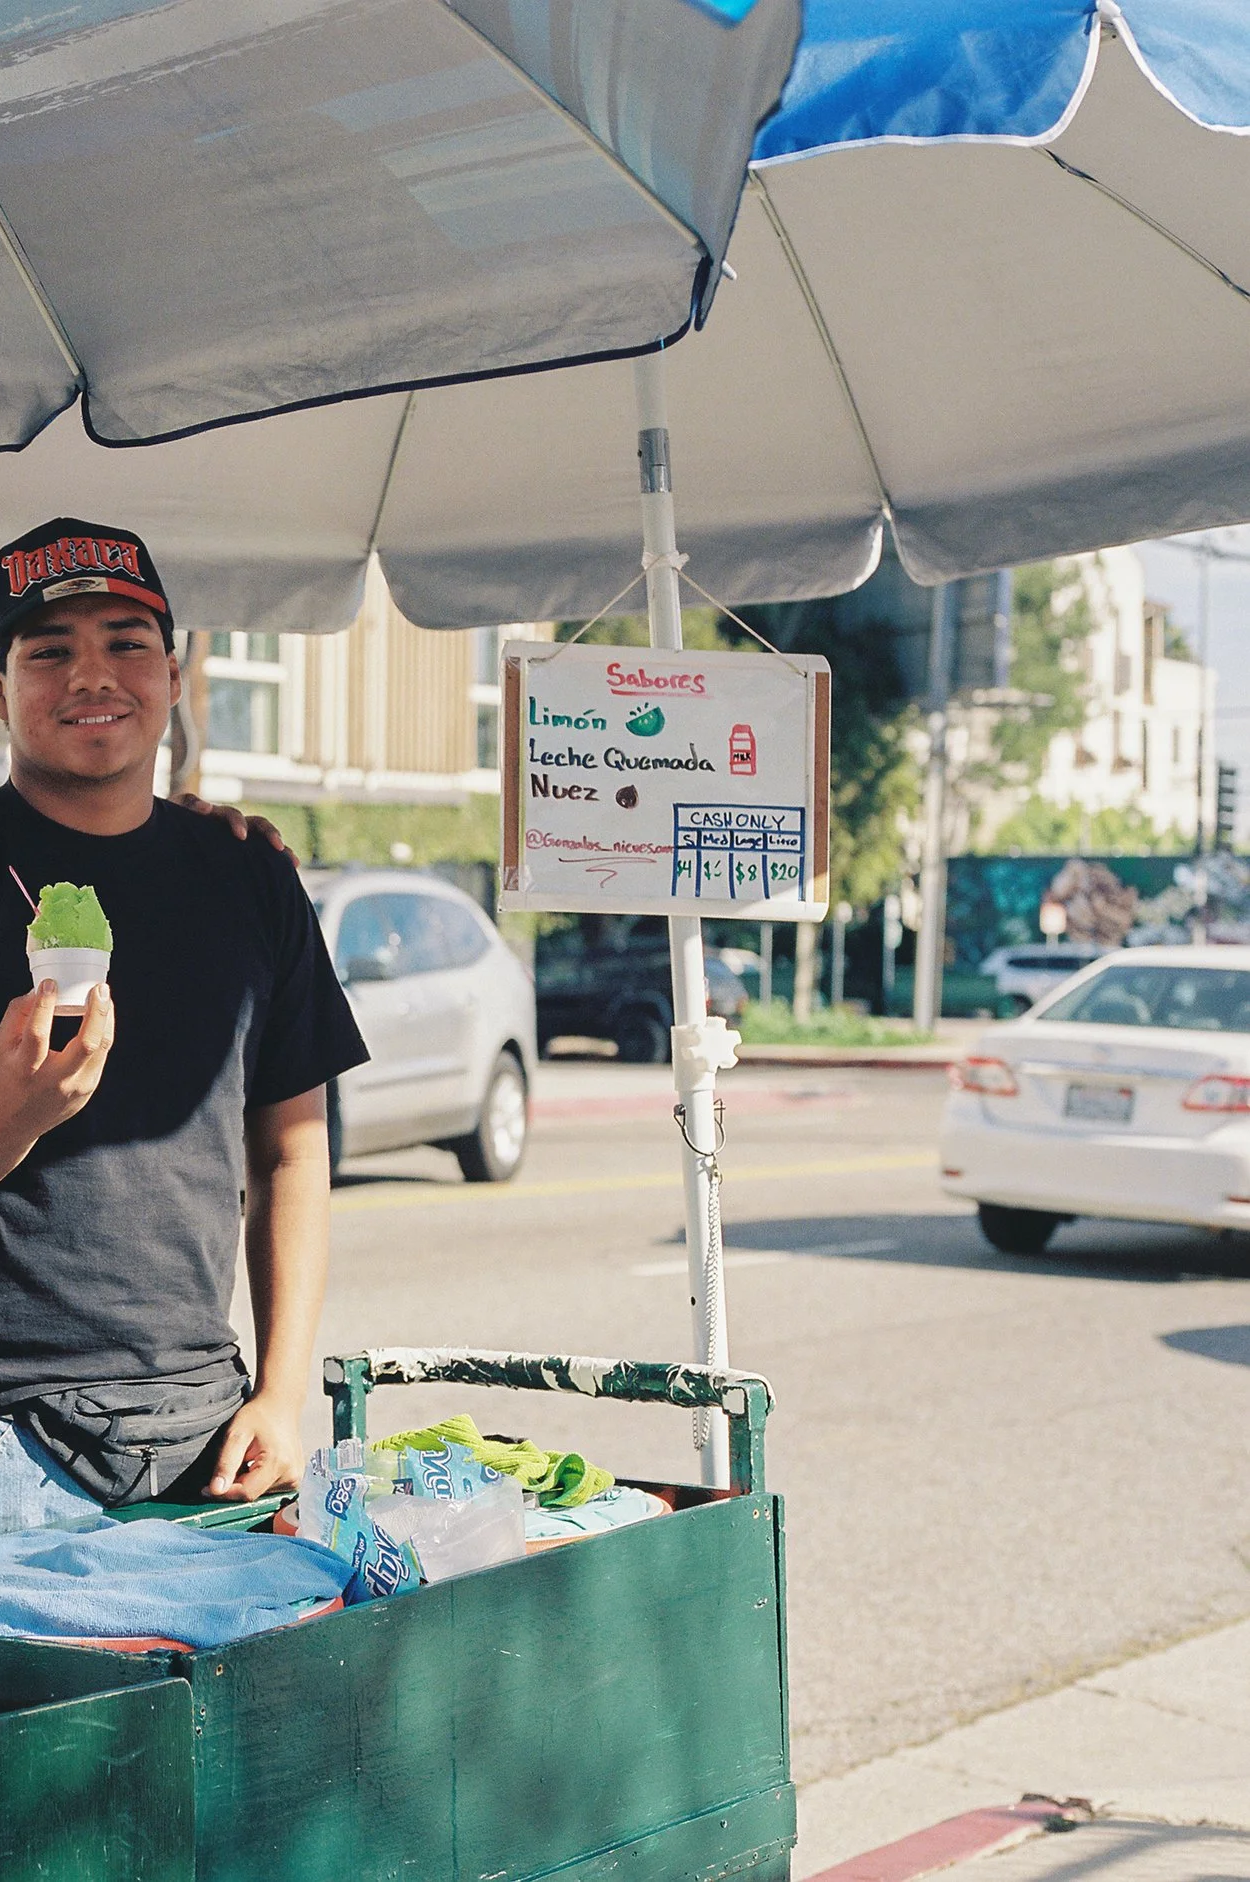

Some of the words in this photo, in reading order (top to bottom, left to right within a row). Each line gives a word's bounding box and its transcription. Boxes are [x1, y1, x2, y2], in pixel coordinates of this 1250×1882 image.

[1, 537, 145, 597] Oaxaca
[606, 662, 705, 693] Sabores
[529, 696, 607, 731] Limón
[529, 738, 598, 769] Leche
[603, 742, 715, 771] Quemada
[530, 773, 600, 801] Nuez
[690, 812, 732, 827] CASH
[735, 813, 785, 831] ONLY
[703, 833, 729, 845] Med
[677, 860, 692, 878] $4
[735, 861, 757, 885] $8
[770, 862, 799, 881] $20
[331, 1478, 353, 1514] 280
